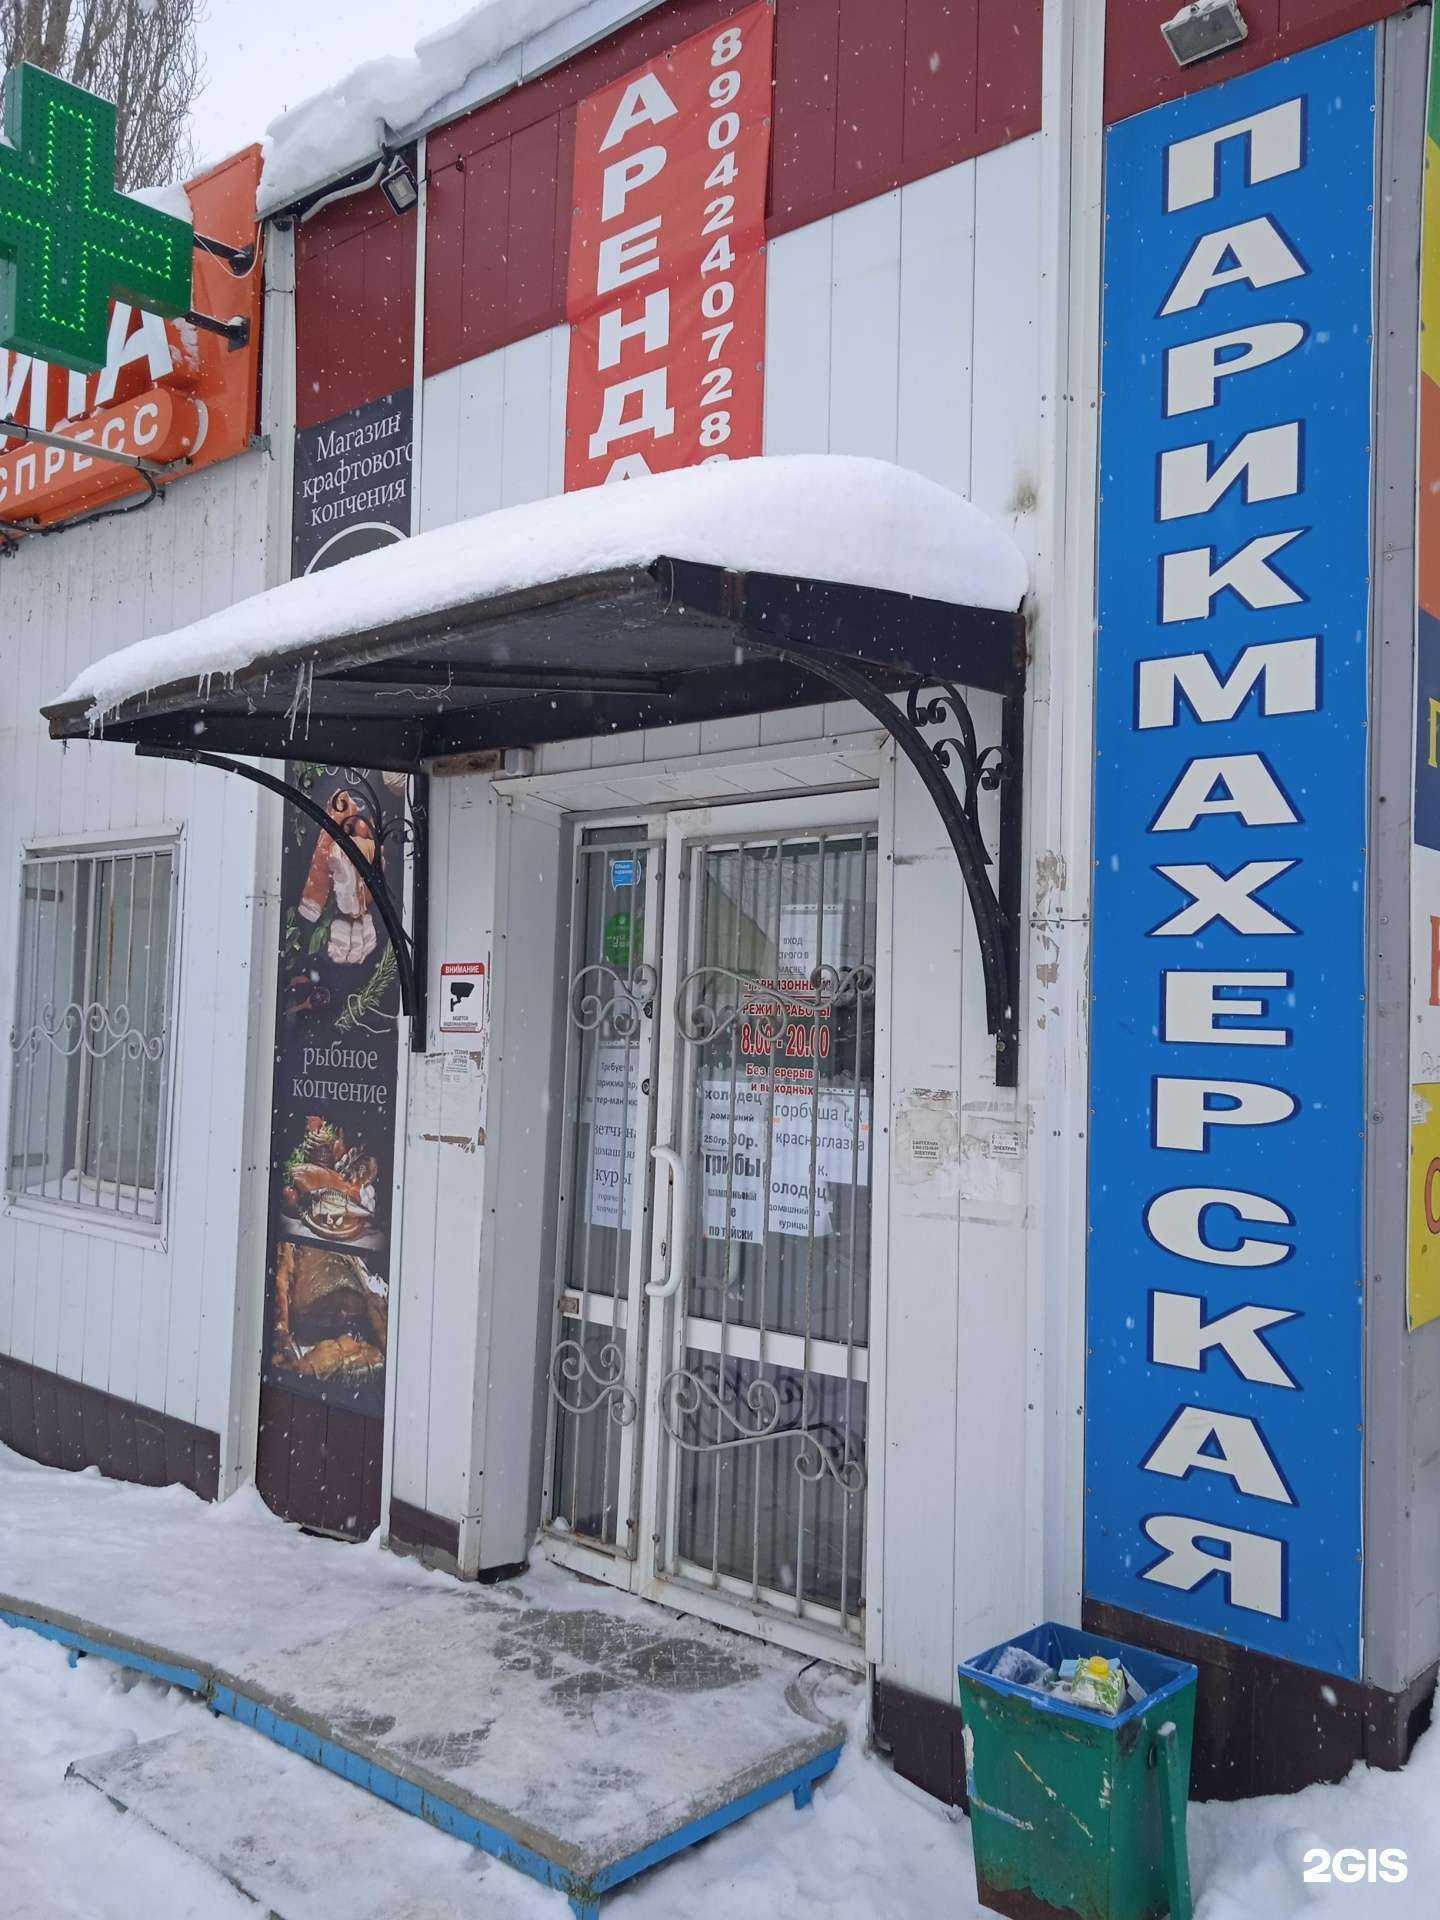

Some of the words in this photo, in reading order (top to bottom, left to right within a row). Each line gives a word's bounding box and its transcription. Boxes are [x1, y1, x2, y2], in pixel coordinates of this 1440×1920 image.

[700, 26, 743, 466] 8904240728
[316, 412, 402, 463] Магазин
[302, 441, 414, 504] крафтового
[310, 478, 407, 527] копчения
[1136, 96, 1320, 1619] ПАРИКМАХЕРСКАЯ
[445, 964, 480, 974] ВНИМАНИЕ
[785, 1003, 831, 1018] РАБОЫ
[302, 1040, 378, 1074] рыбное
[746, 1063, 767, 1077] Без
[768, 1066, 820, 1081] ерерыв
[292, 1079, 388, 1104] копчение
[710, 1113, 755, 1122] домний
[775, 1132, 865, 1151] красноглаза
[770, 1182, 826, 1203] олодц
[721, 1226, 753, 1240] тйски
